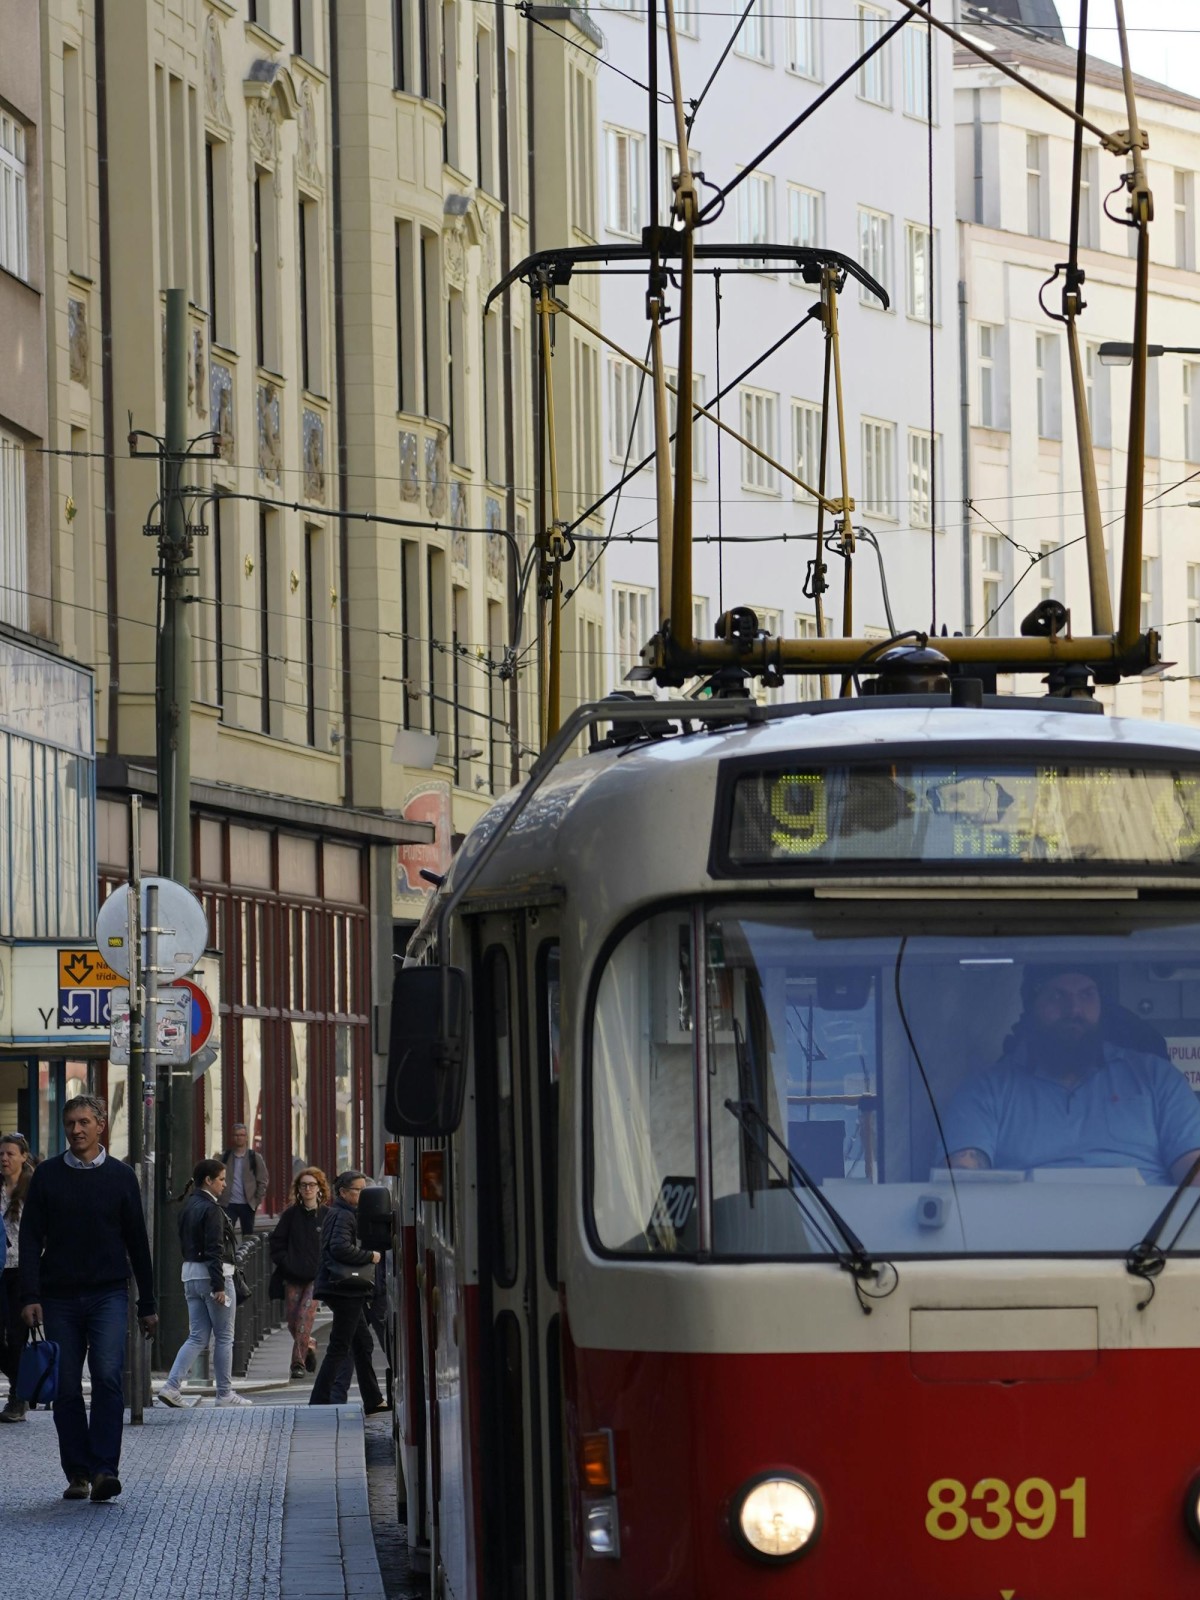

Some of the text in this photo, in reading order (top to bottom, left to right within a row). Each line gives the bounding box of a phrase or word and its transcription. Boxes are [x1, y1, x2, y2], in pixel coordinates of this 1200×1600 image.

[771, 774, 828, 854] 9
[96, 972, 117, 981] třída
[925, 1477, 1086, 1541] 8391
